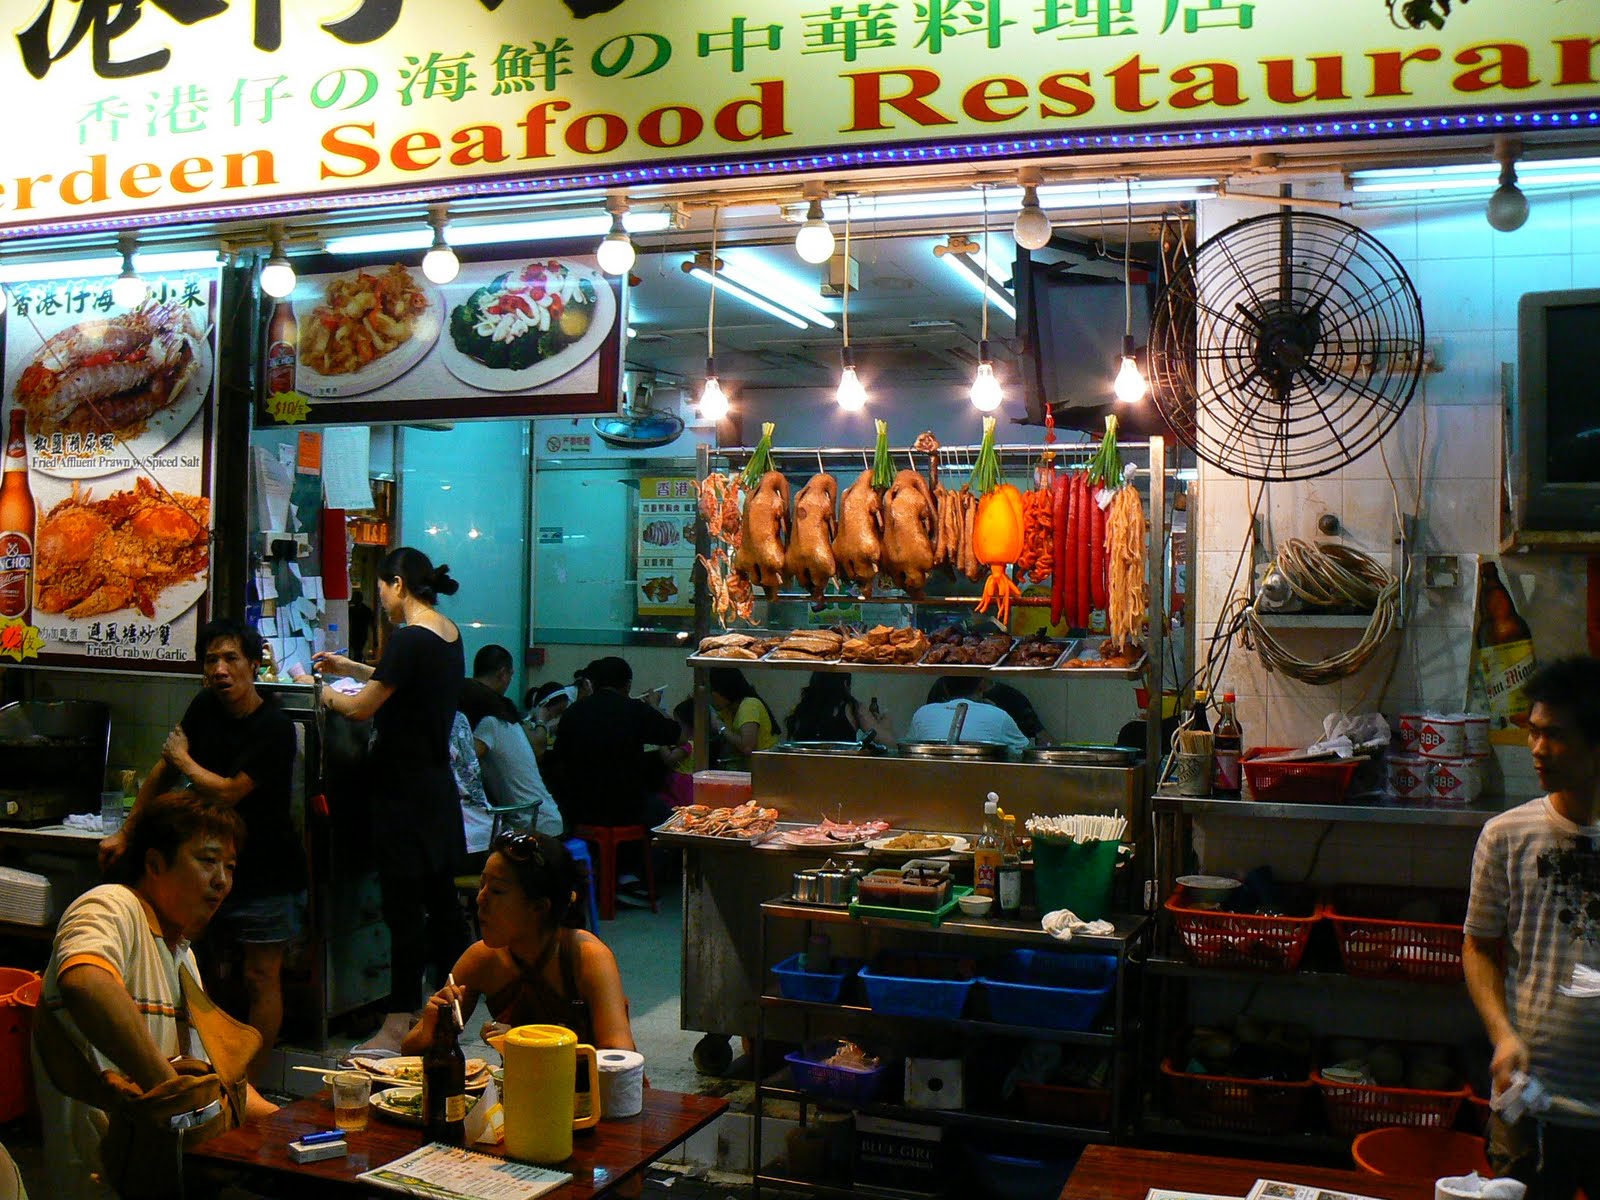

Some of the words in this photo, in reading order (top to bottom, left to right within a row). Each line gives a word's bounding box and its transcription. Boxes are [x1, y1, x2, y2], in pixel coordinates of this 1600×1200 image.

[0, 153, 277, 210] rdeen
[320, 79, 792, 181] Seafood
[12, 276, 206, 317] 香港仔海小菜
[32, 457, 57, 468] Fried
[60, 456, 96, 468] Affluent
[100, 457, 130, 468] Prawn
[146, 456, 178, 470] Spiced
[180, 456, 200, 467] Salt
[86, 644, 111, 657] Fried
[114, 646, 139, 658] Crab
[141, 648, 153, 658] w/
[155, 648, 187, 661] Garlic
